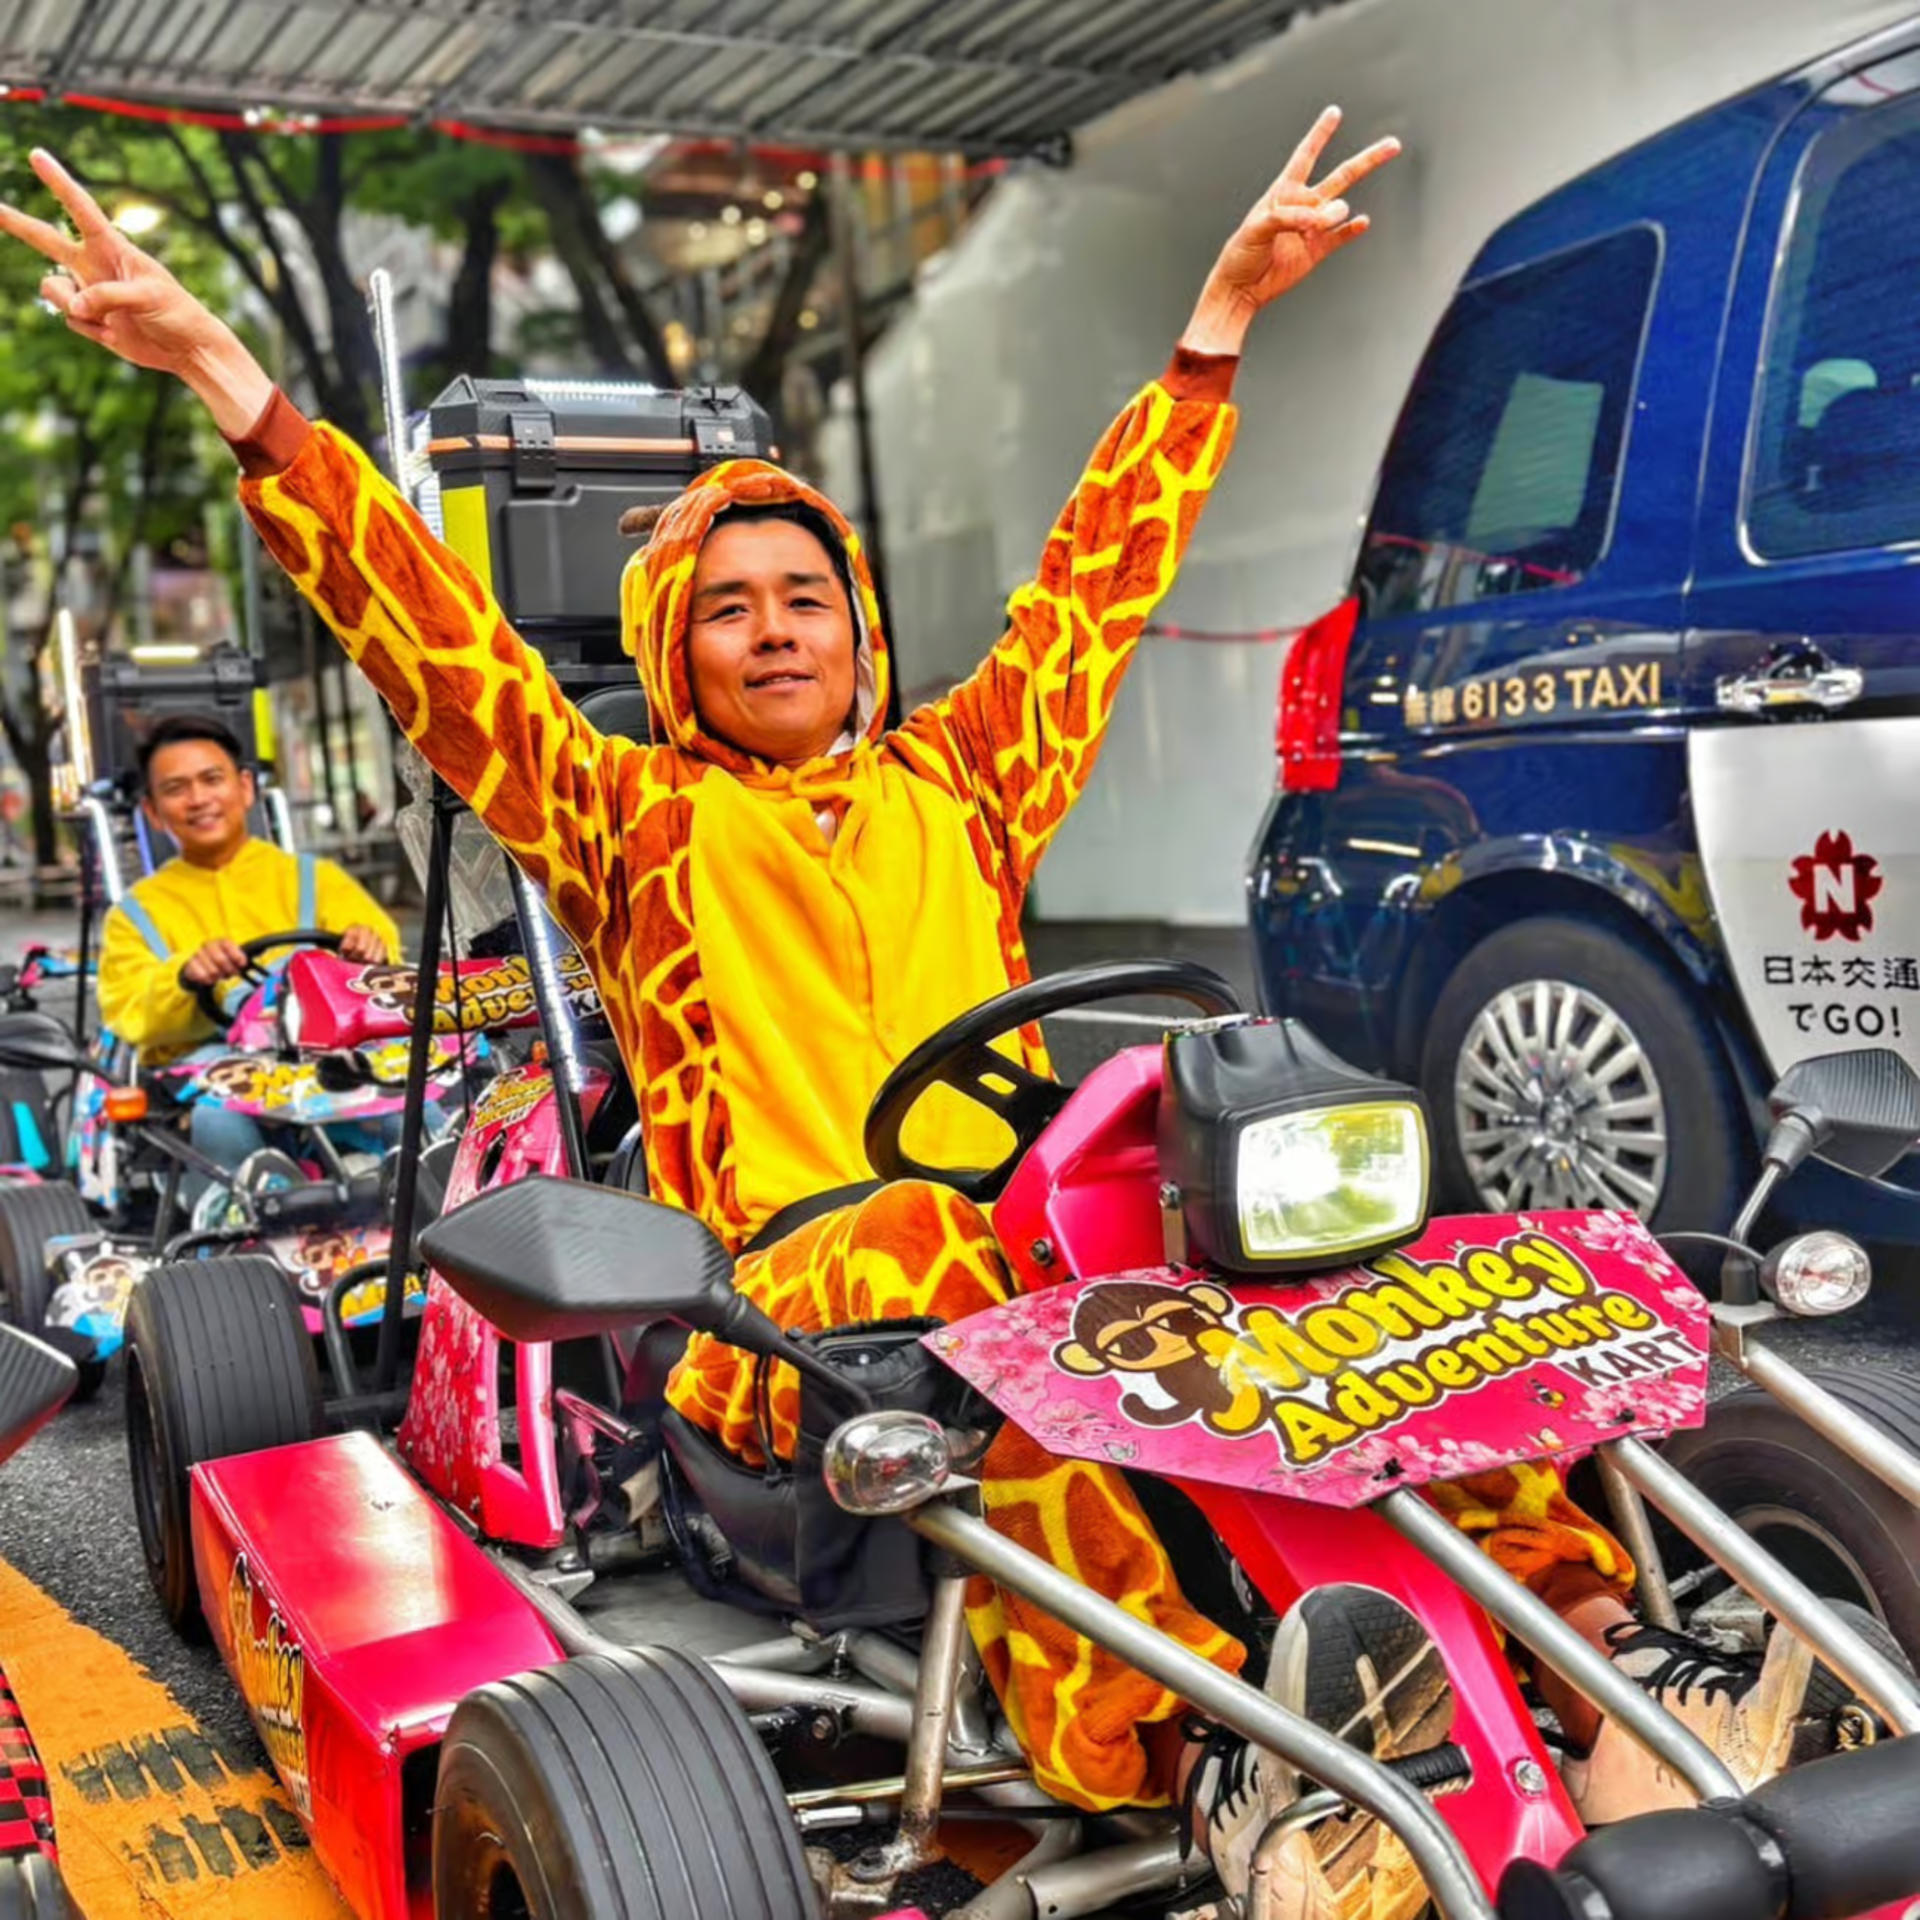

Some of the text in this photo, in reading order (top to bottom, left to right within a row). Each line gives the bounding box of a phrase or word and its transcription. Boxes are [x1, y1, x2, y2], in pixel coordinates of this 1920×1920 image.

[1462, 673, 1556, 719] 6133
[1564, 662, 1660, 709] TAXI
[1813, 863, 1856, 914] N
[1764, 954, 1919, 991] 日本交通
[1788, 1003, 1900, 1038] でGO!
[1196, 1234, 1590, 1432] Monkey
[1563, 1330, 1703, 1388] KART
[1274, 1296, 1658, 1462] Adventure
